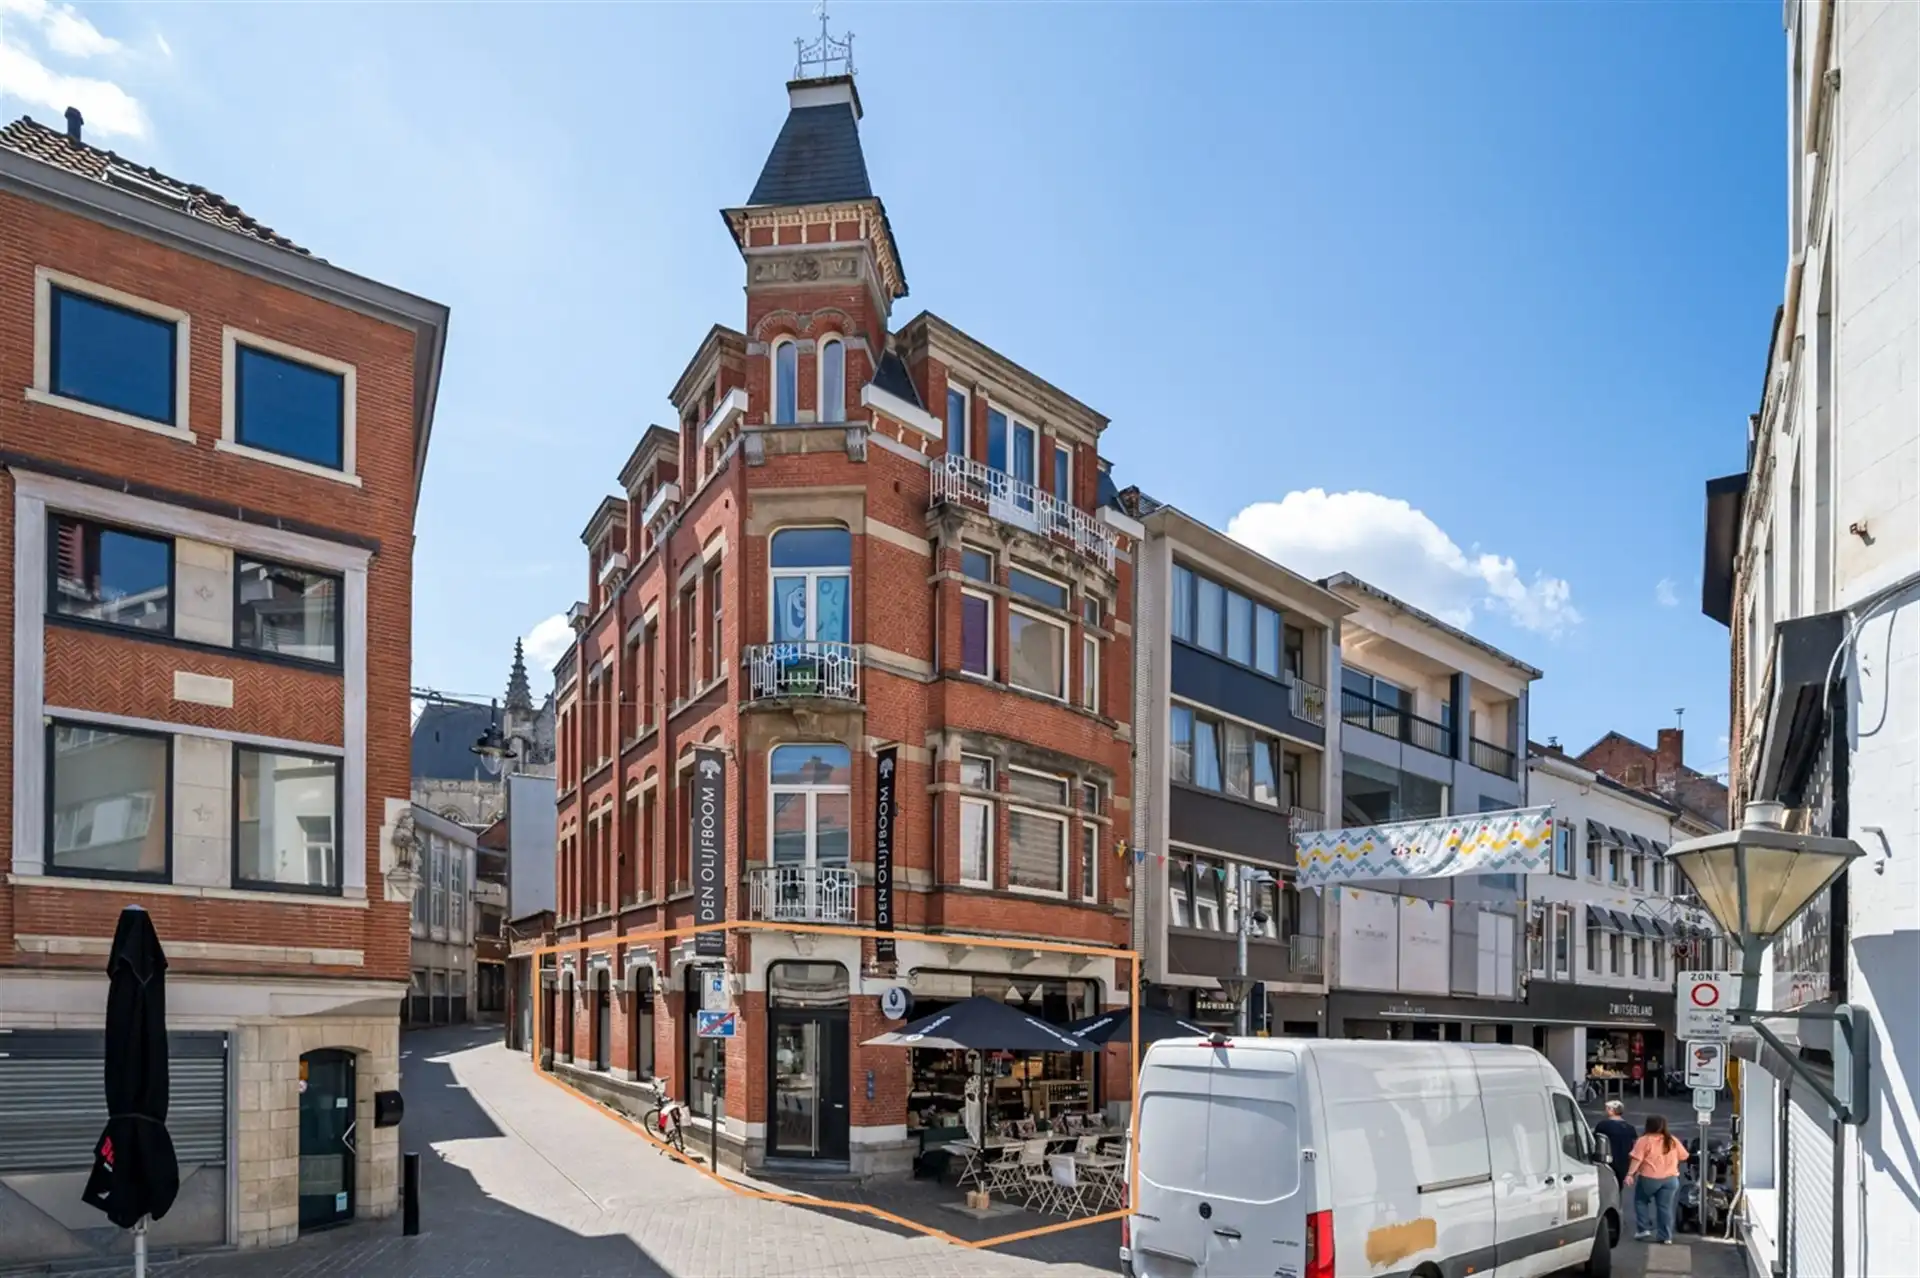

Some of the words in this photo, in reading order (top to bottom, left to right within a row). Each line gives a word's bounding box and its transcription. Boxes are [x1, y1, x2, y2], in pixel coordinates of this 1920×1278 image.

[701, 787, 717, 882] OLIJFBOOM
[878, 786, 890, 884] OLIJFBOOM
[701, 886, 715, 921] DEN
[878, 888, 889, 924] DEN
[1690, 973, 1721, 981] ZONE
